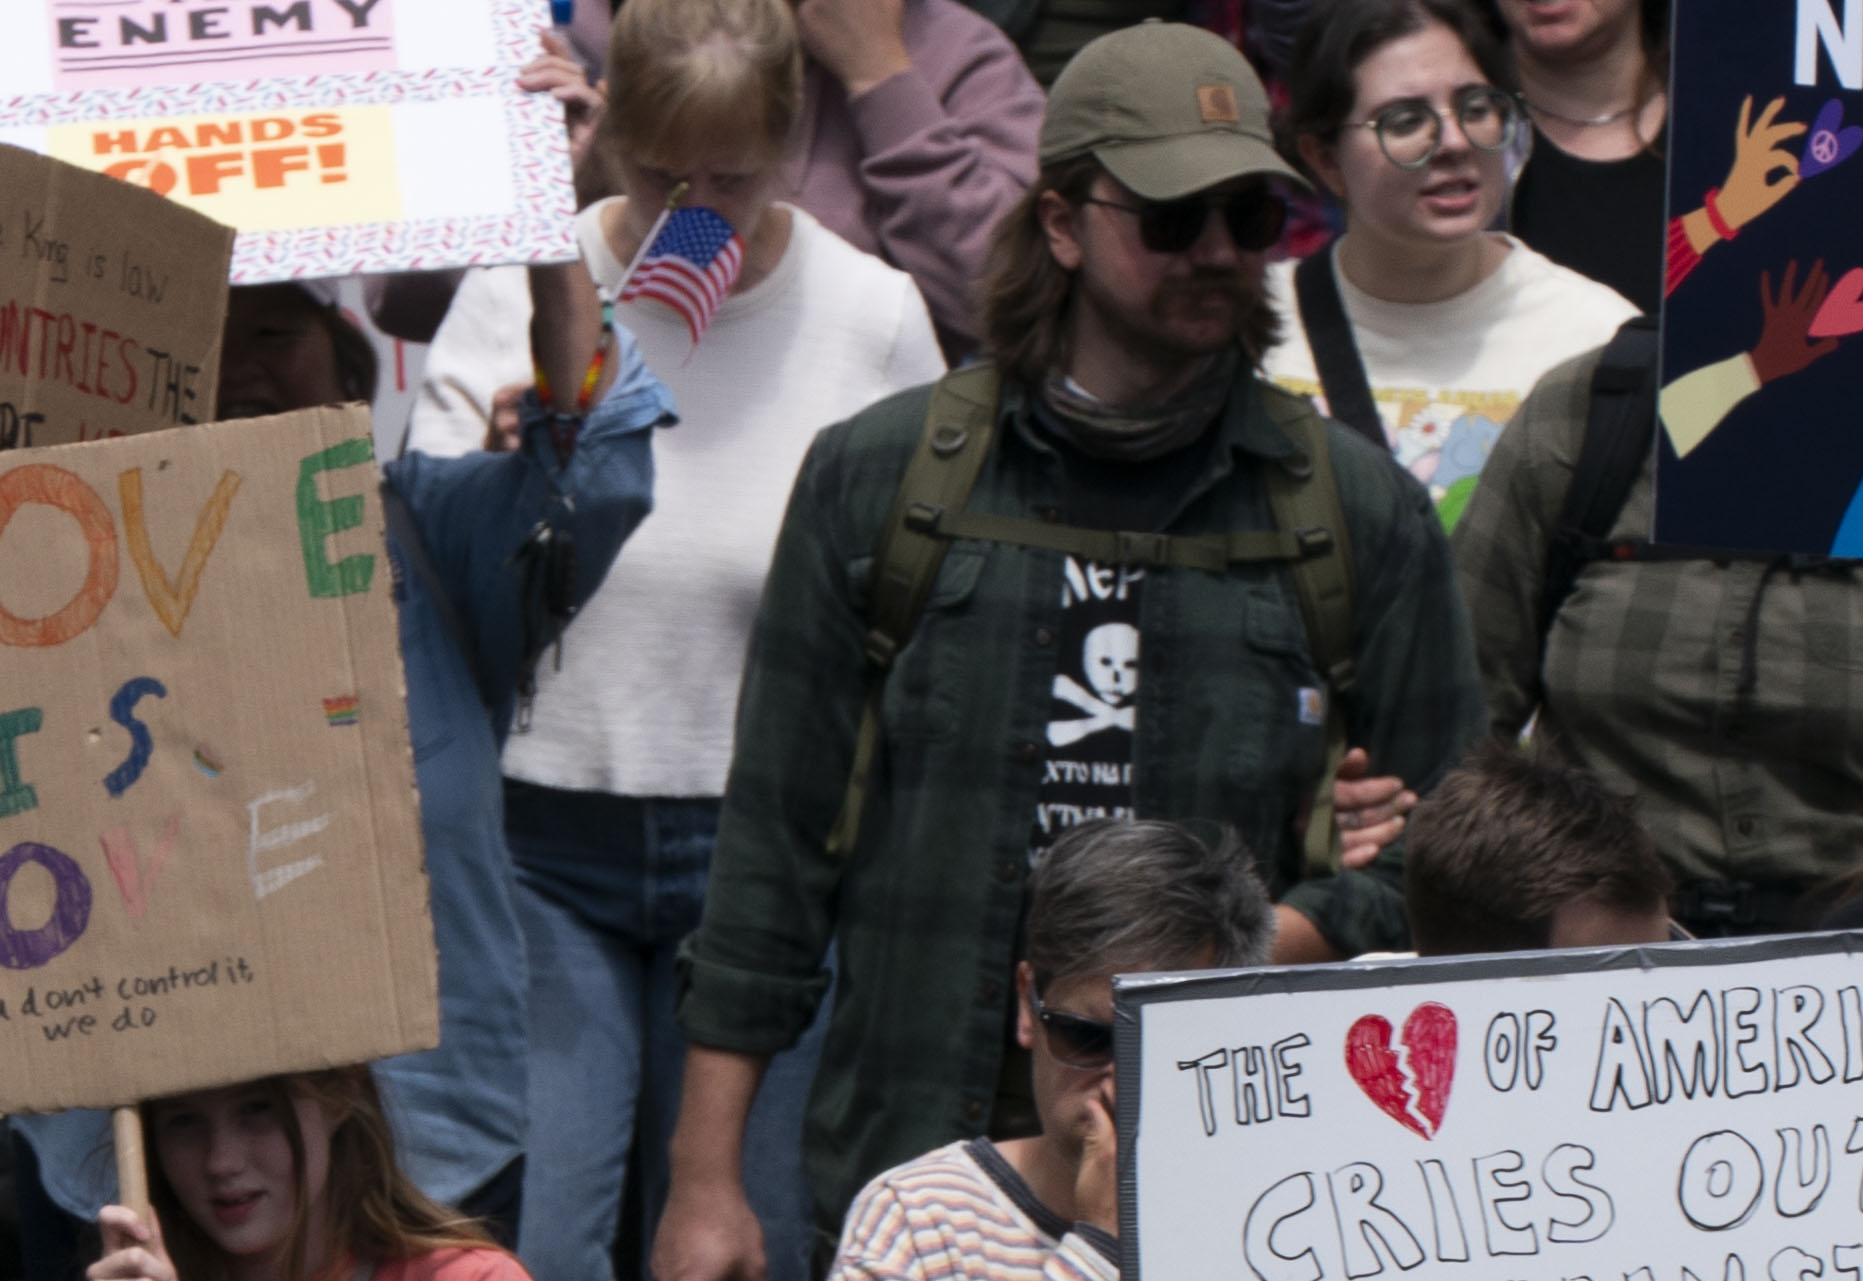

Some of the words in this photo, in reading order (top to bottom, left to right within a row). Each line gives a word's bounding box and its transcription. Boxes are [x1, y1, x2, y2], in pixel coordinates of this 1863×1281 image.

[57, 0, 380, 48] ENEMY
[93, 113, 343, 155] HANDS
[101, 143, 348, 198] OFF!
[22, 209, 70, 284] King
[85, 250, 105, 280] is
[145, 345, 203, 426] THE
[116, 958, 219, 996] control
[42, 1009, 96, 1044] we
[111, 1002, 157, 1034] do
[1176, 1033, 1311, 1137] THE
[1484, 1009, 1557, 1092] OF
